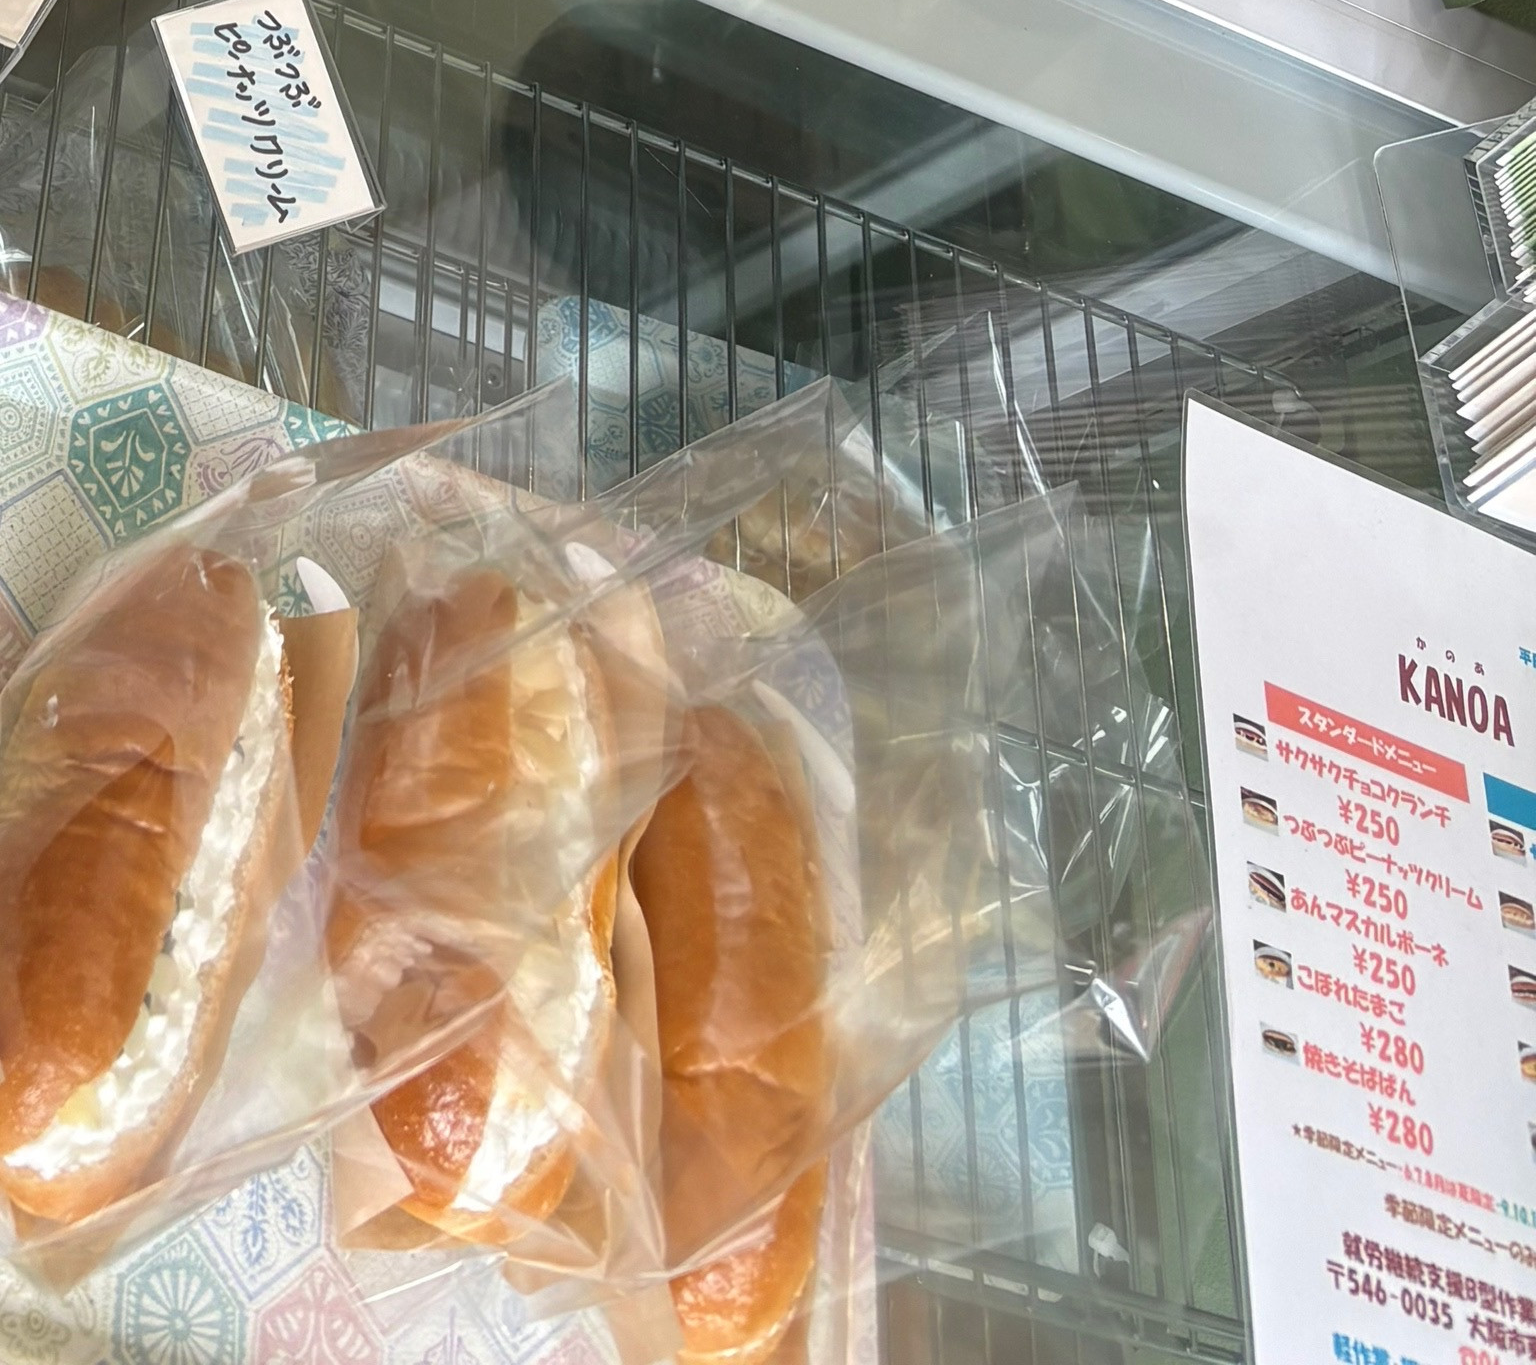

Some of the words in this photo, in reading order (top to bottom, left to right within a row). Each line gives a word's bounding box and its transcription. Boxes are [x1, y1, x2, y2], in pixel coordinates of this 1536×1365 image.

[257, 10, 323, 110] つぶつぶ
[214, 22, 296, 224] ピーナッツクリーム
[1398, 653, 1515, 747] KANOA
[1297, 705, 1437, 774] スタンダードメニュー
[1275, 738, 1452, 829] サクサクチョコクランチ
[1337, 795, 1400, 847] ¥250
[1283, 814, 1484, 911] つぶつぶピーナッツクリーム
[1345, 869, 1408, 920] ¥250
[1290, 887, 1449, 968] あんマスカルポーネ
[1352, 944, 1416, 997] ¥250
[1359, 1021, 1425, 1075] ¥280
[1367, 1101, 1434, 1157] ¥280
